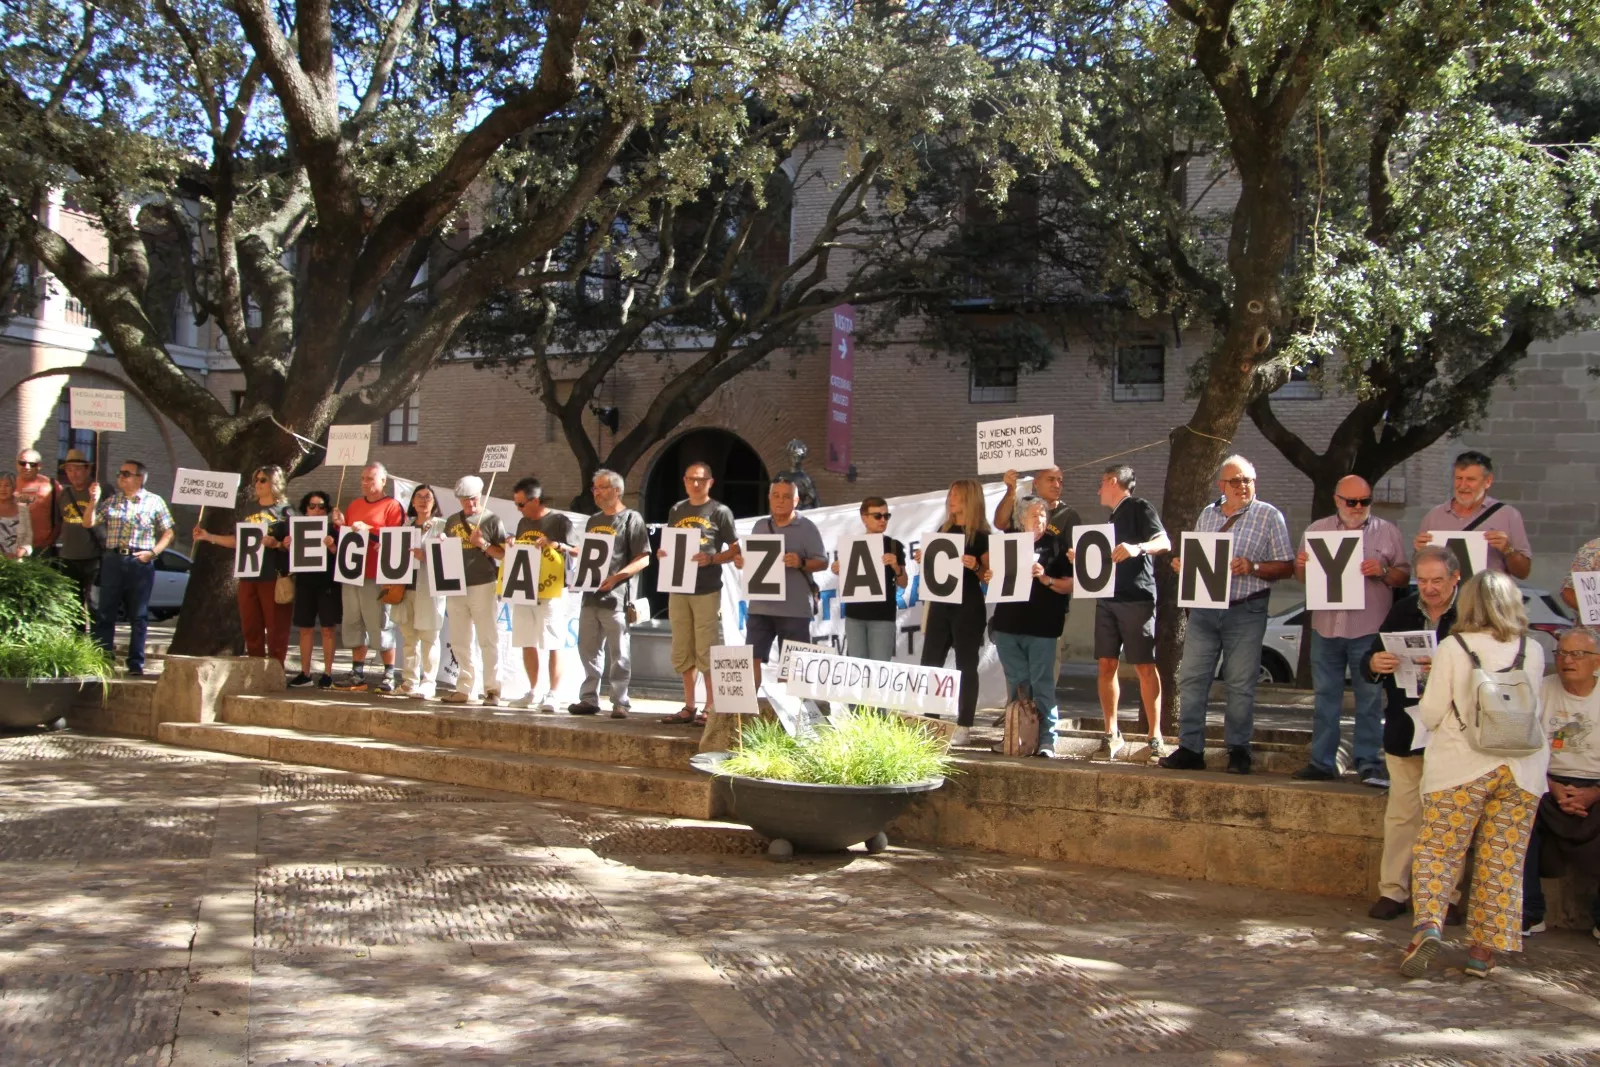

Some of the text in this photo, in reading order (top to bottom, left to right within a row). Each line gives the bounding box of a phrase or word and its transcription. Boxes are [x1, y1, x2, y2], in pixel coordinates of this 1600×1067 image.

[978, 425, 1042, 439] SI VIENEN RICOS
[486, 445, 508, 453] NINGUNA
[980, 437, 1041, 450] TURISMO, SI NO,
[338, 445, 356, 461] YA!
[484, 453, 508, 461] PERSONA
[979, 447, 1048, 460] ABUSO Y RACISMO
[183, 477, 224, 489] FUIMOS EXILIO
[179, 486, 229, 499] SEAMOS REFUGIO
[1580, 577, 1596, 590] NO
[714, 659, 749, 670] CONSTRUYAMOS
[720, 672, 742, 682] PUENTES
[793, 656, 871, 689] ACOGIDA
[878, 665, 929, 695] DIGNA
[934, 672, 955, 698] YA
[718, 685, 744, 697] NO MUROS
